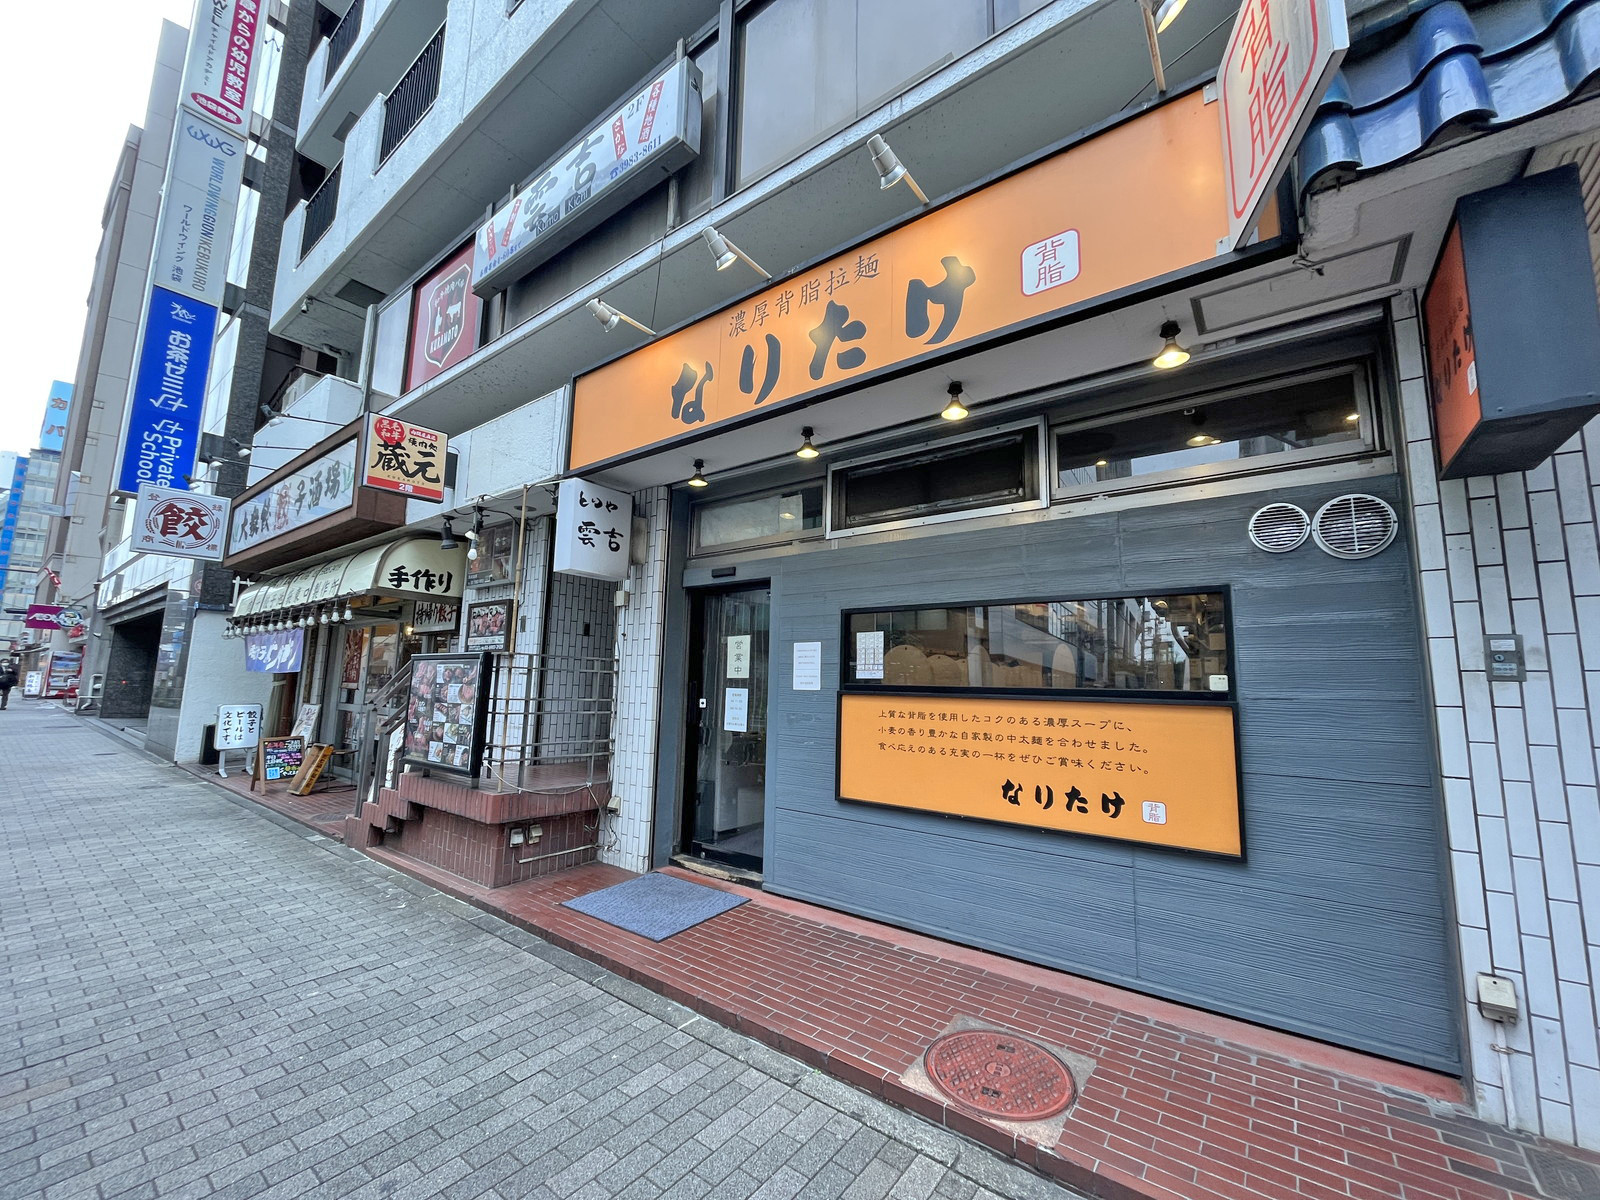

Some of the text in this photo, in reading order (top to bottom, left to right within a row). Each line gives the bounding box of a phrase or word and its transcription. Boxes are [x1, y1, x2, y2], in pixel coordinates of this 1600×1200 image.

[626, 94, 645, 119] 2F
[1034, 238, 1066, 289] 背脂
[729, 253, 880, 338] 濃厚背脂拉麺
[671, 255, 977, 425] なりたけ
[380, 428, 401, 440] 和牛
[136, 431, 163, 485] School
[156, 435, 183, 488] Private
[371, 440, 441, 484] 蔵元
[398, 483, 414, 493] 2階
[577, 520, 624, 552] 雲吉
[388, 565, 453, 593] 手作り
[734, 639, 744, 675] 営業中
[234, 710, 245, 741] ビールは
[246, 710, 258, 734] 餃子と
[877, 709, 1132, 732] 上質な背脂を使用したコクのある濃厚スープに、
[877, 725, 1149, 754] 小麦の香り豊かな自家製の中太麺を合わせました。
[877, 741, 1150, 775] 食べ応えのある充実の一杯をぜひご賞味ください。
[1001, 778, 1126, 819] なりたけ
[1147, 803, 1161, 822] 背脂
